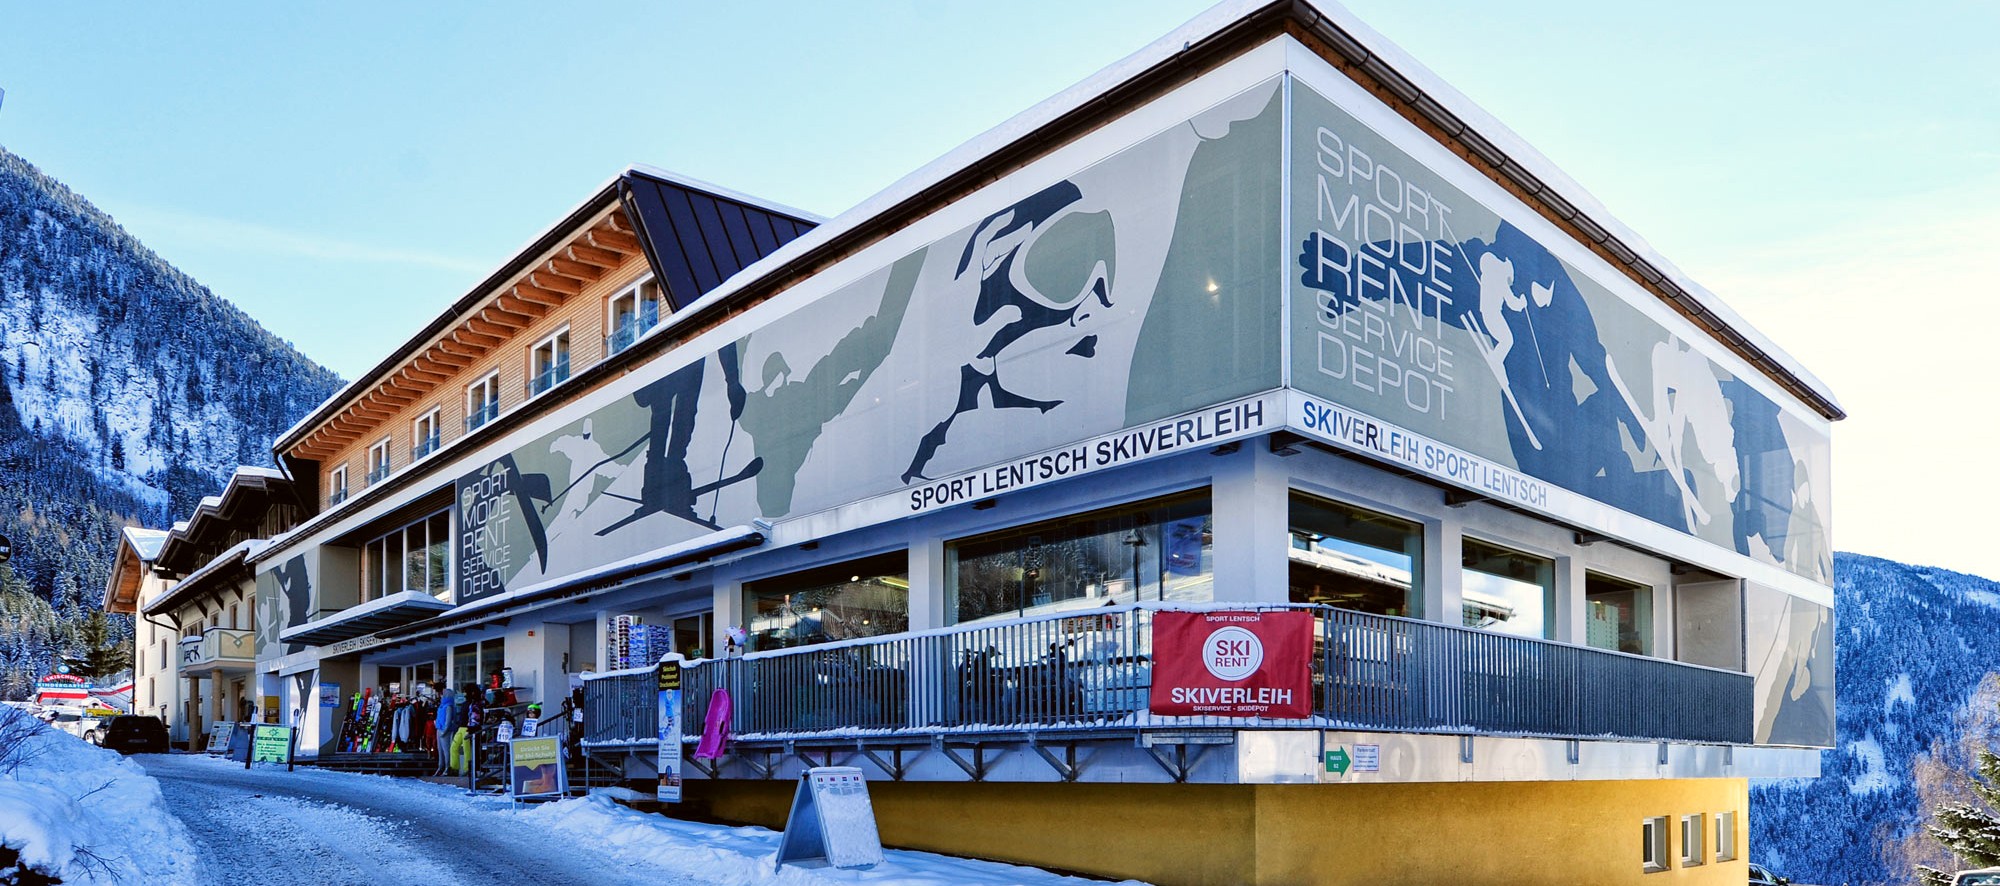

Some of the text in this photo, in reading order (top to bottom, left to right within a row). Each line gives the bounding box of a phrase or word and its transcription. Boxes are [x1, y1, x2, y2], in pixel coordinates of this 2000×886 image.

[1316, 126, 1452, 239] SPORT
[1317, 173, 1453, 292] MODE
[1317, 228, 1453, 340] RENT
[1316, 290, 1453, 381] SERVICE
[1317, 330, 1454, 421] DEPOT
[911, 400, 1263, 510] SPORT LENTSCH SKIVERLEIH
[1303, 400, 1547, 508] SKIVERLEIH SPORT LENTSCH
[462, 467, 511, 506] SPORT
[462, 490, 511, 531] MODE
[462, 516, 511, 558] RENT
[462, 544, 511, 576] SERVICE
[462, 565, 511, 597] DEPOT
[1215, 657, 1249, 667] RENT
[1216, 640, 1250, 656] SKI
[45, 674, 83, 683] SKISCHULE
[1171, 687, 1292, 705] SKIVERLEIH
